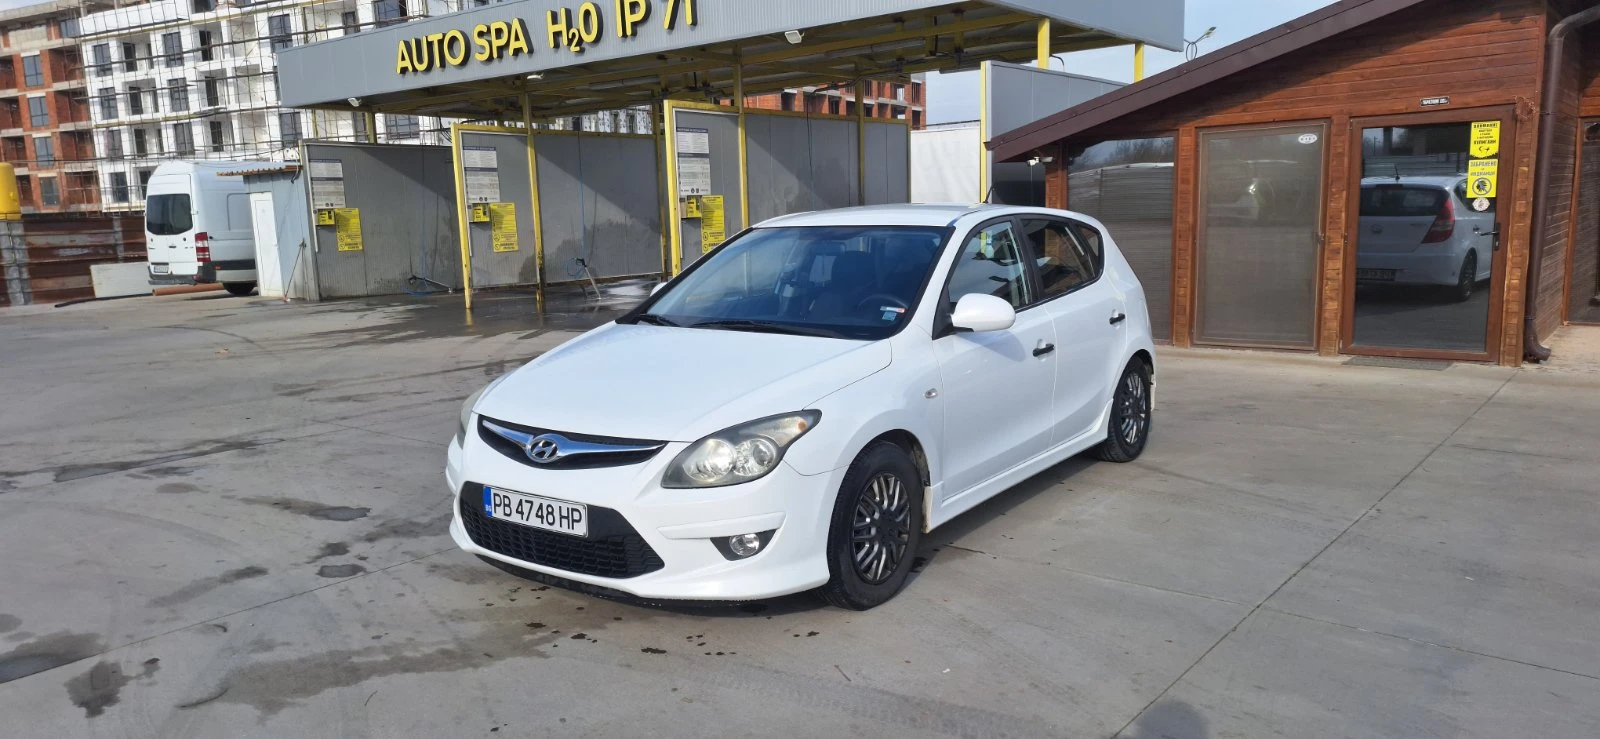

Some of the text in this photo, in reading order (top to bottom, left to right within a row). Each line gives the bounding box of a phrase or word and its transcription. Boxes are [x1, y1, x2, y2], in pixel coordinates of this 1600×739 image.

[396, 29, 466, 74] AUTO
[473, 17, 530, 62] SPA
[493, 492, 582, 530] PB 4748 HP
